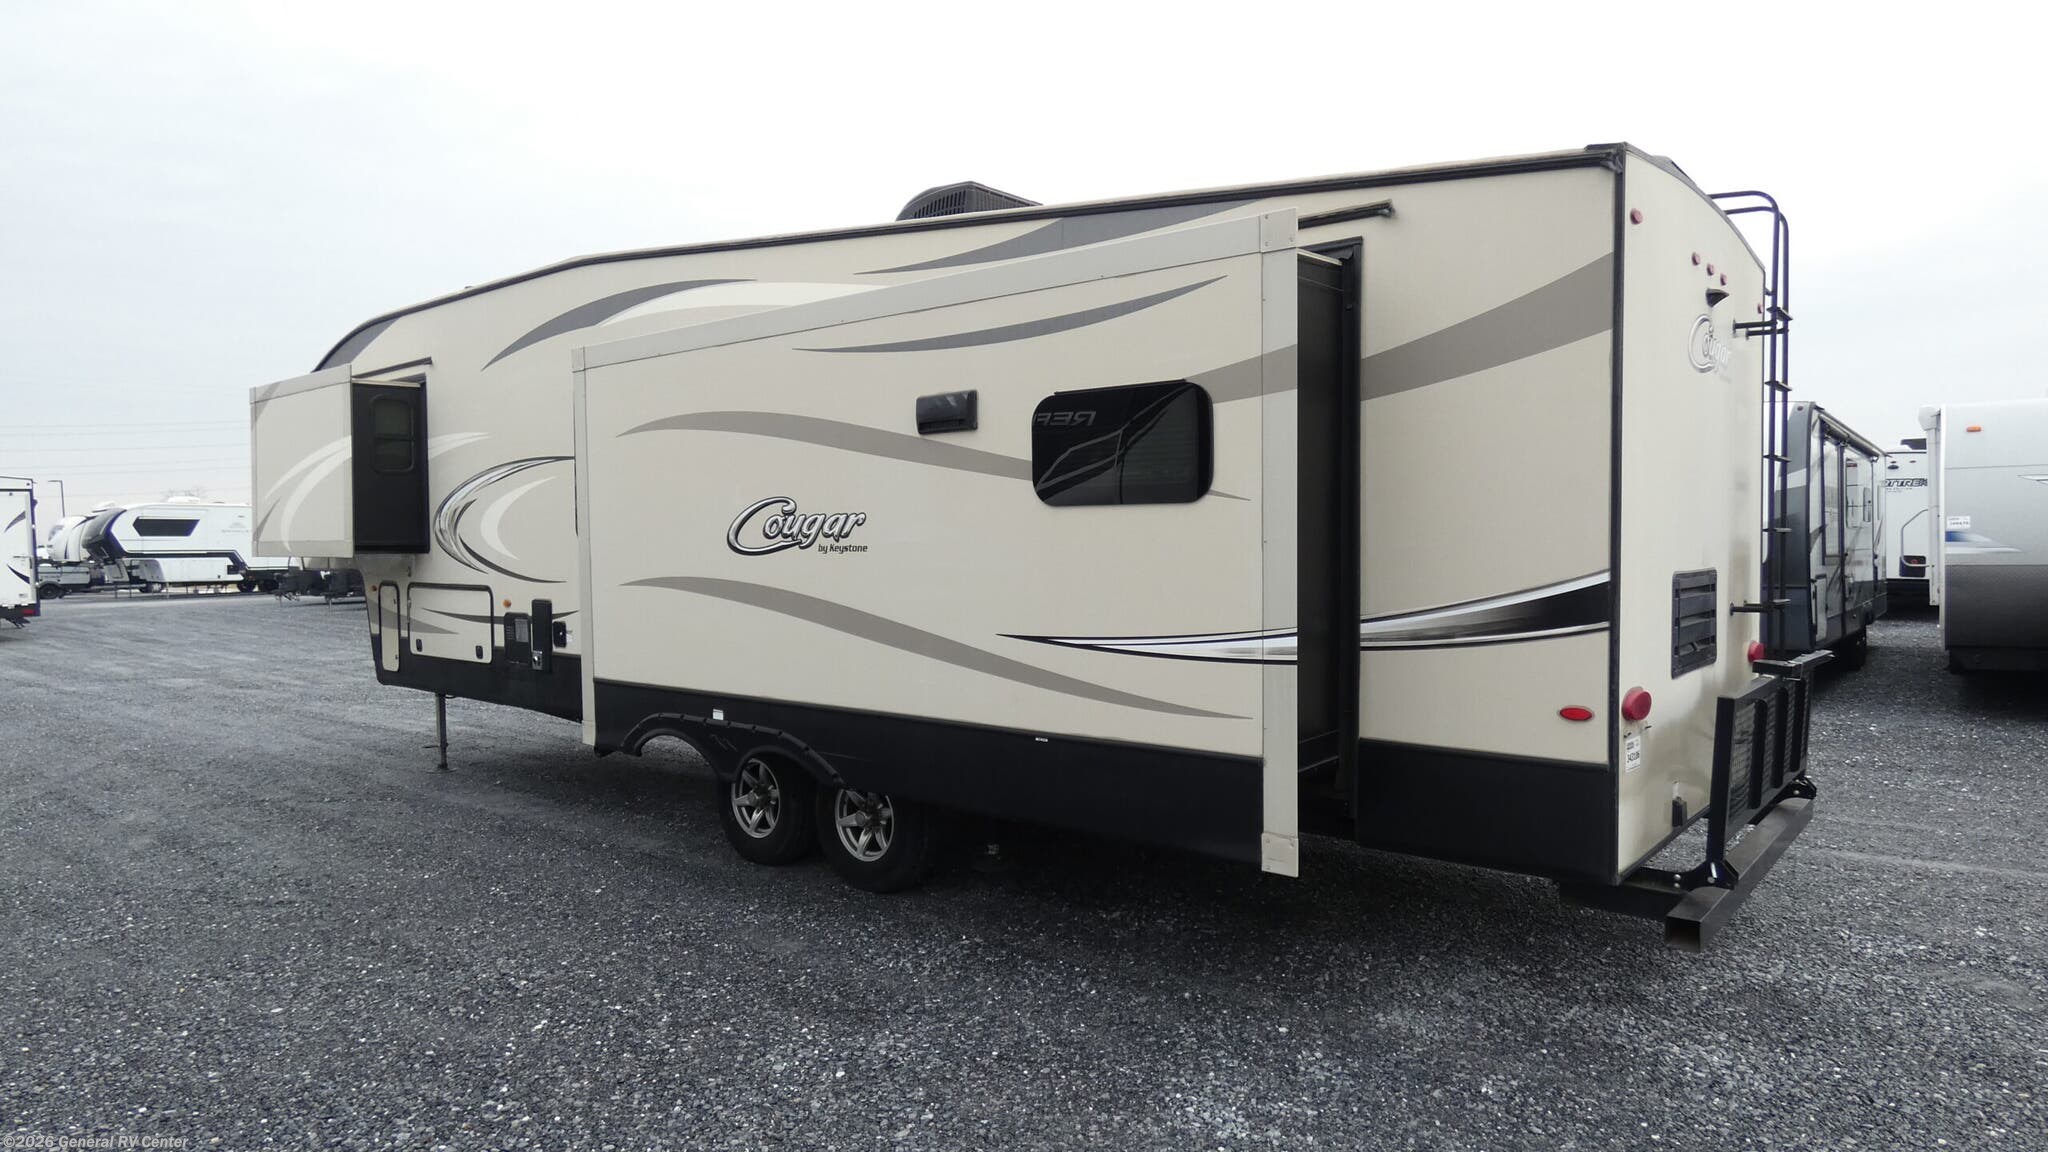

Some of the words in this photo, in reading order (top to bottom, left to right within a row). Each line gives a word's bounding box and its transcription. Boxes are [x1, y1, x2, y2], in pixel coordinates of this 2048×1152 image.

[727, 496, 867, 556] Cougar
[818, 544, 828, 554] by
[829, 543, 868, 554] Keystone
